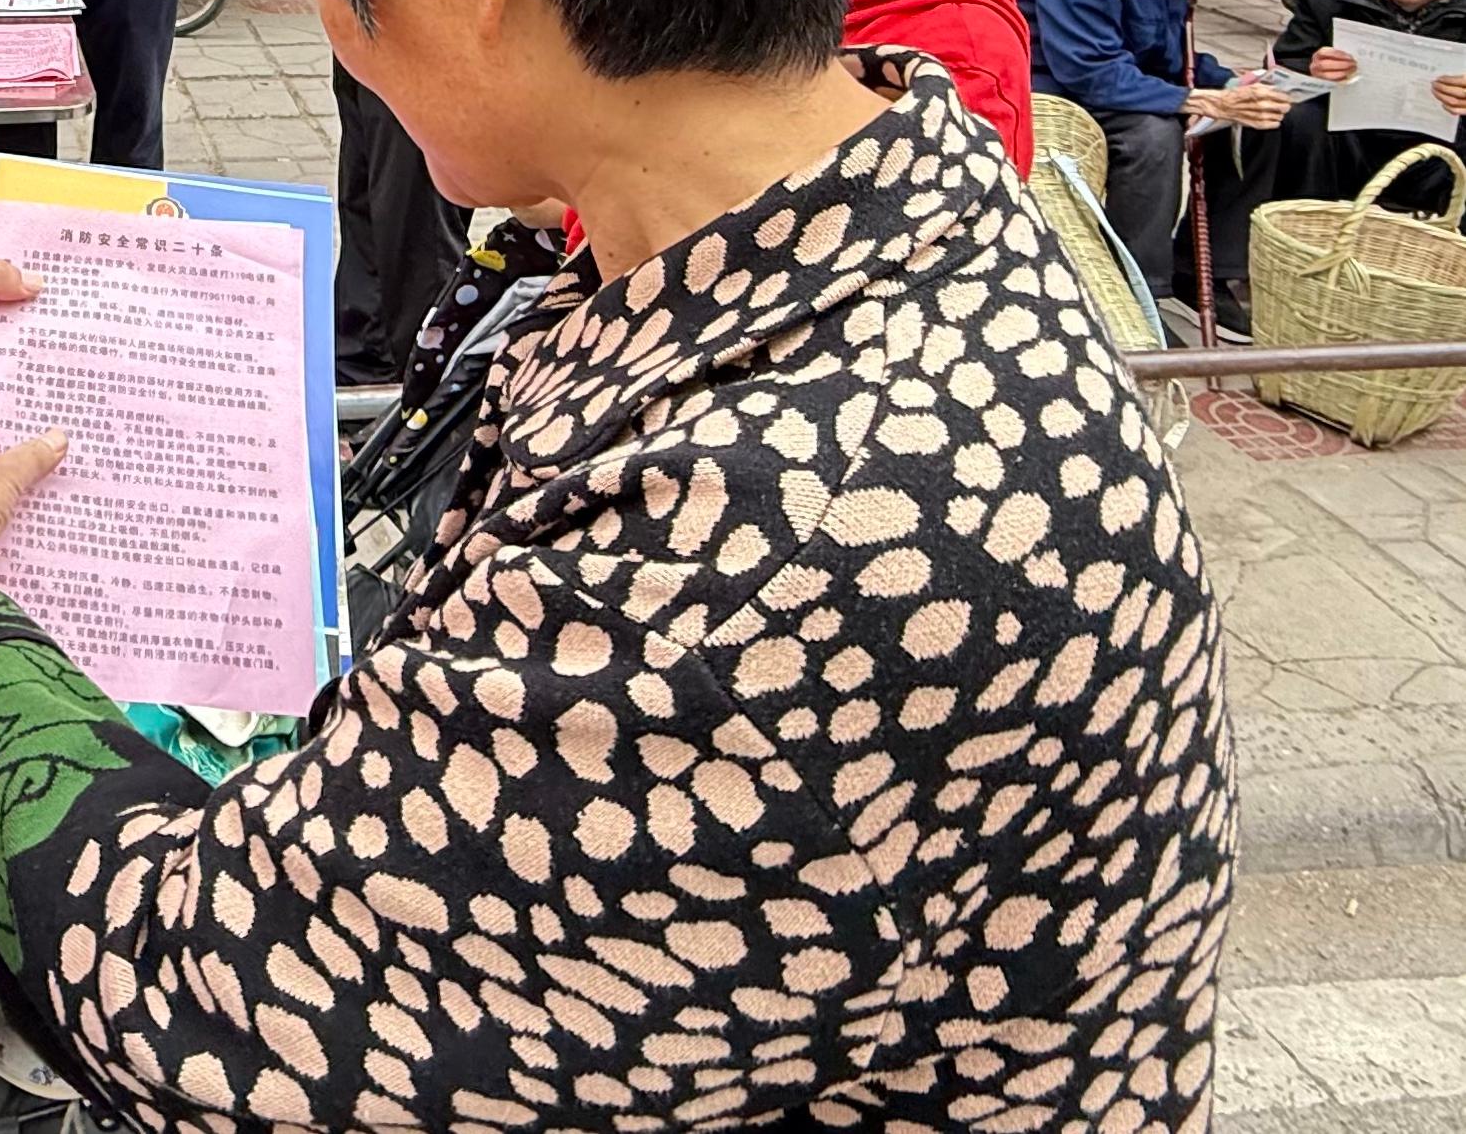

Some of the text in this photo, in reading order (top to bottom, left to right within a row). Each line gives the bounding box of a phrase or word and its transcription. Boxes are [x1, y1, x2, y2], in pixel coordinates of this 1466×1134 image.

[60, 228, 223, 258] 消防安全常识二十条
